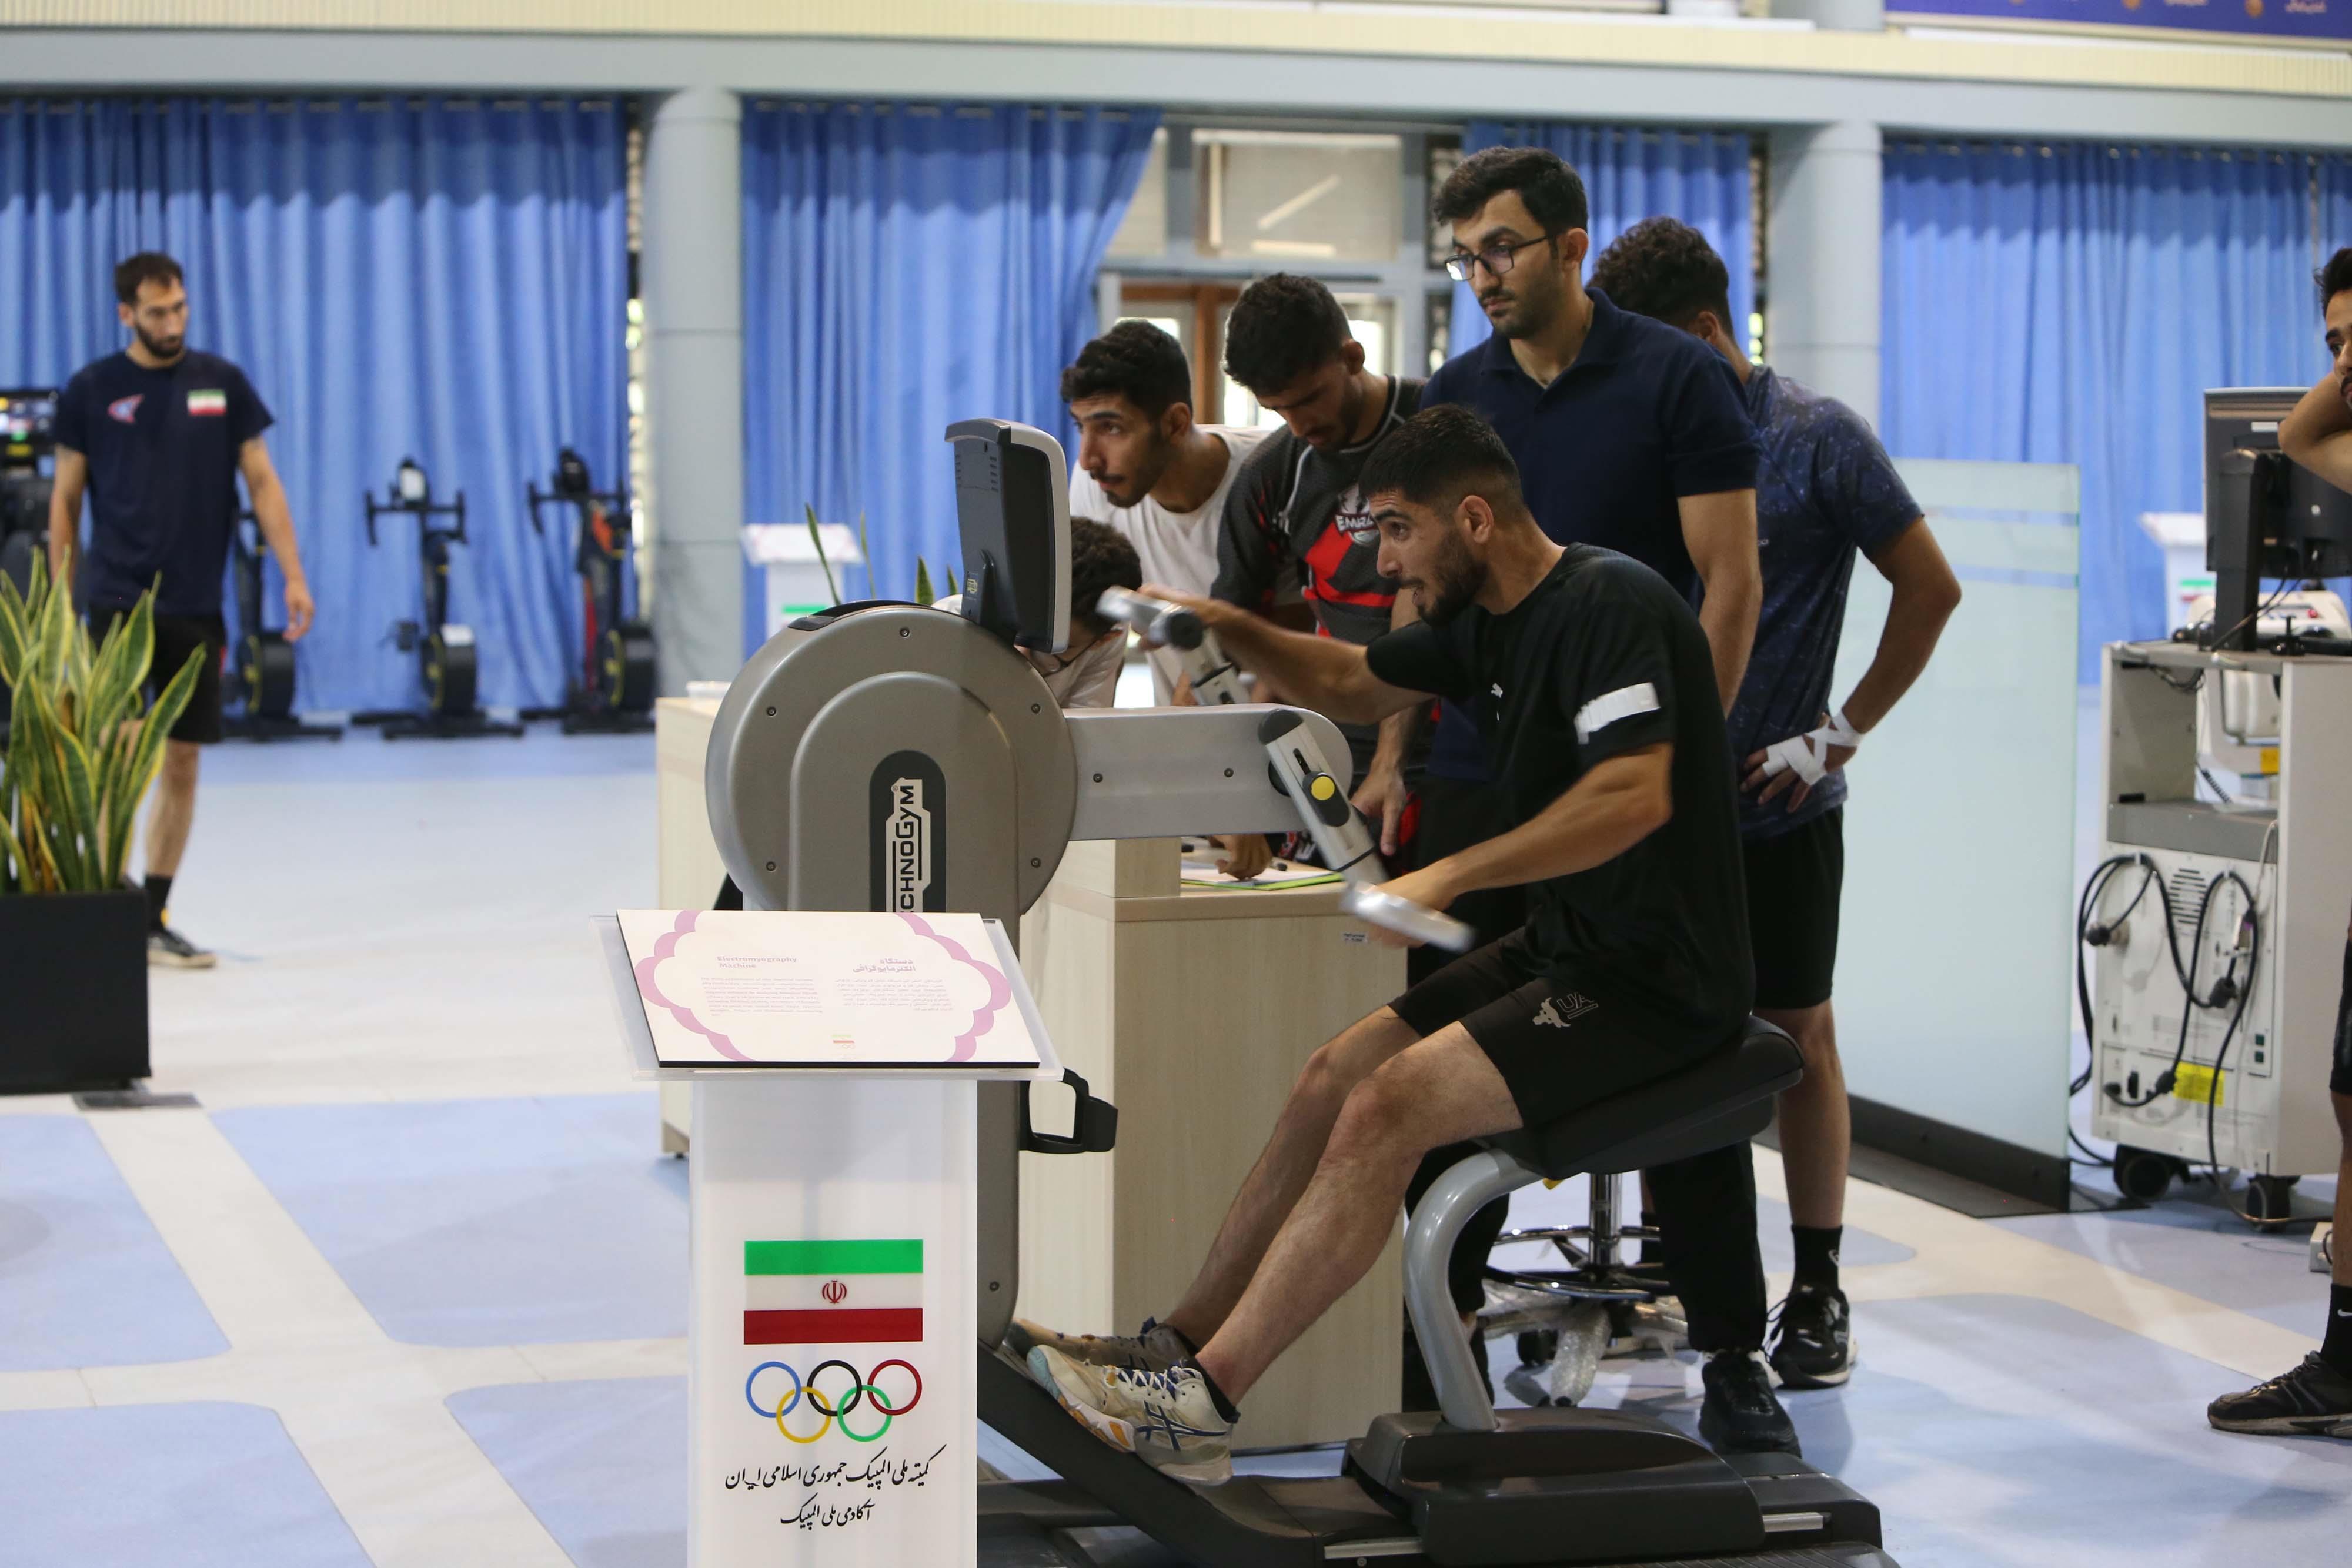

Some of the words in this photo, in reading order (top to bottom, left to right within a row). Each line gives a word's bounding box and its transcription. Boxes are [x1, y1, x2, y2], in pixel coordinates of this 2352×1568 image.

[893, 785, 921, 912] CHNOGYM
[725, 1467, 761, 1491] ایران
[763, 1464, 801, 1488] اسلامی
[803, 1462, 847, 1487] جمهوری
[846, 1446, 890, 1490] المپیک
[892, 1459, 908, 1485] ملی
[908, 1444, 946, 1487] کمیته
[781, 1492, 820, 1530] المپیک
[822, 1504, 836, 1527] ملی
[837, 1497, 875, 1527] آکادمی
